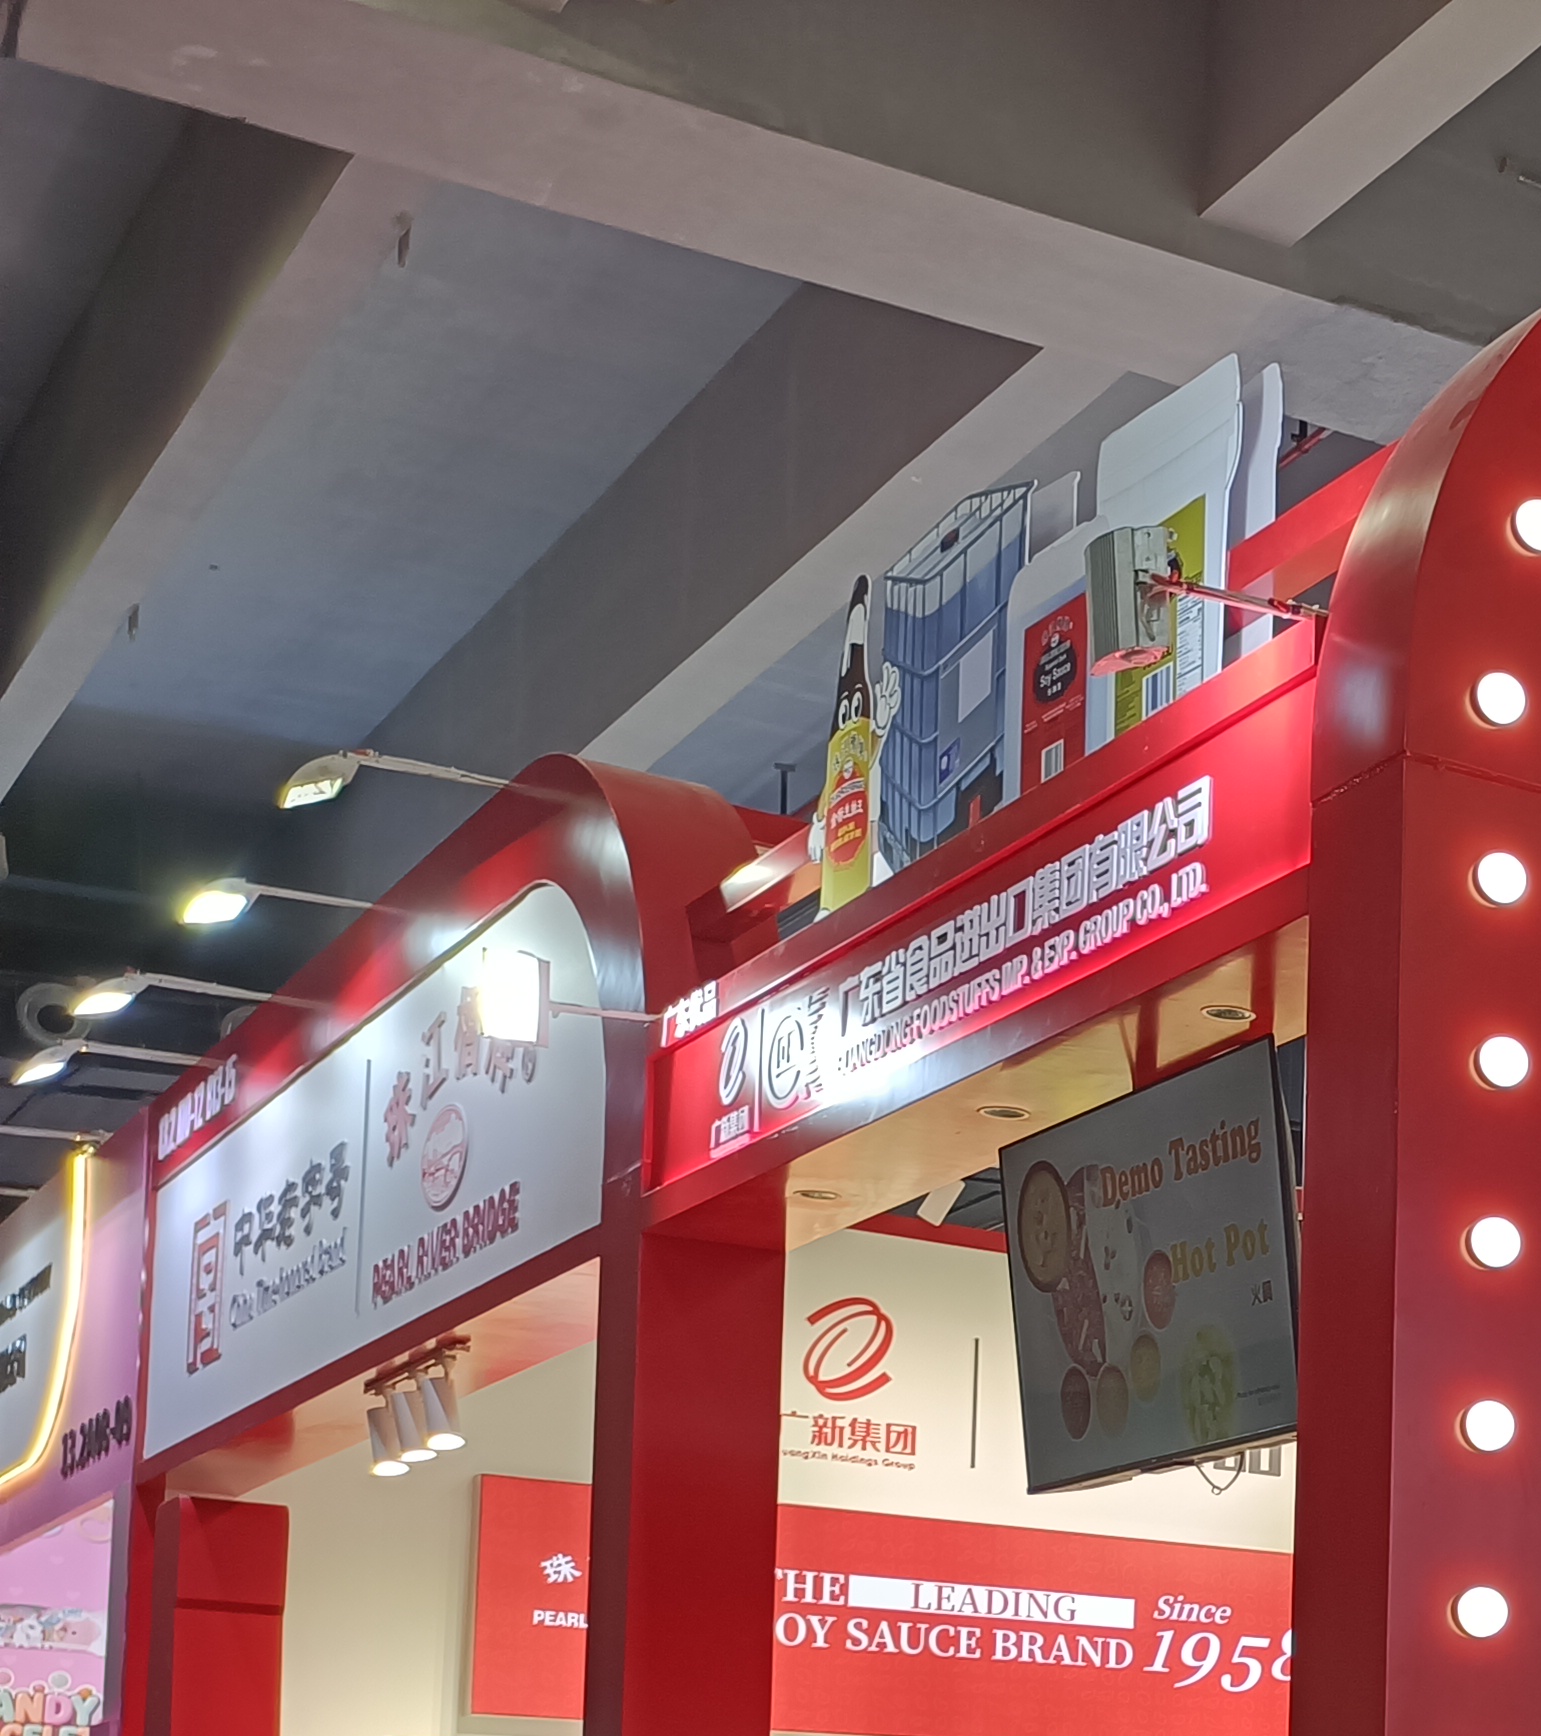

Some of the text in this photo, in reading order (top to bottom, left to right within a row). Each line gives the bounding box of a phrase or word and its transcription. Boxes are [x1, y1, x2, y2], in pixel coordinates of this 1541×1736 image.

[838, 1014, 911, 1074] UANGDONG
[1078, 904, 1135, 955] GROUP
[1100, 1115, 1263, 1208] Demo Tasting
[372, 1180, 521, 1308] PEARL RIVER BRIDGE
[1170, 1218, 1271, 1285] Hot Pot
[532, 1609, 589, 1630] PEARL
[910, 1581, 1078, 1622] LEADING
[1152, 1594, 1232, 1626] Since
[845, 1617, 983, 1661] SAUCE
[991, 1627, 1135, 1671] BRAND
